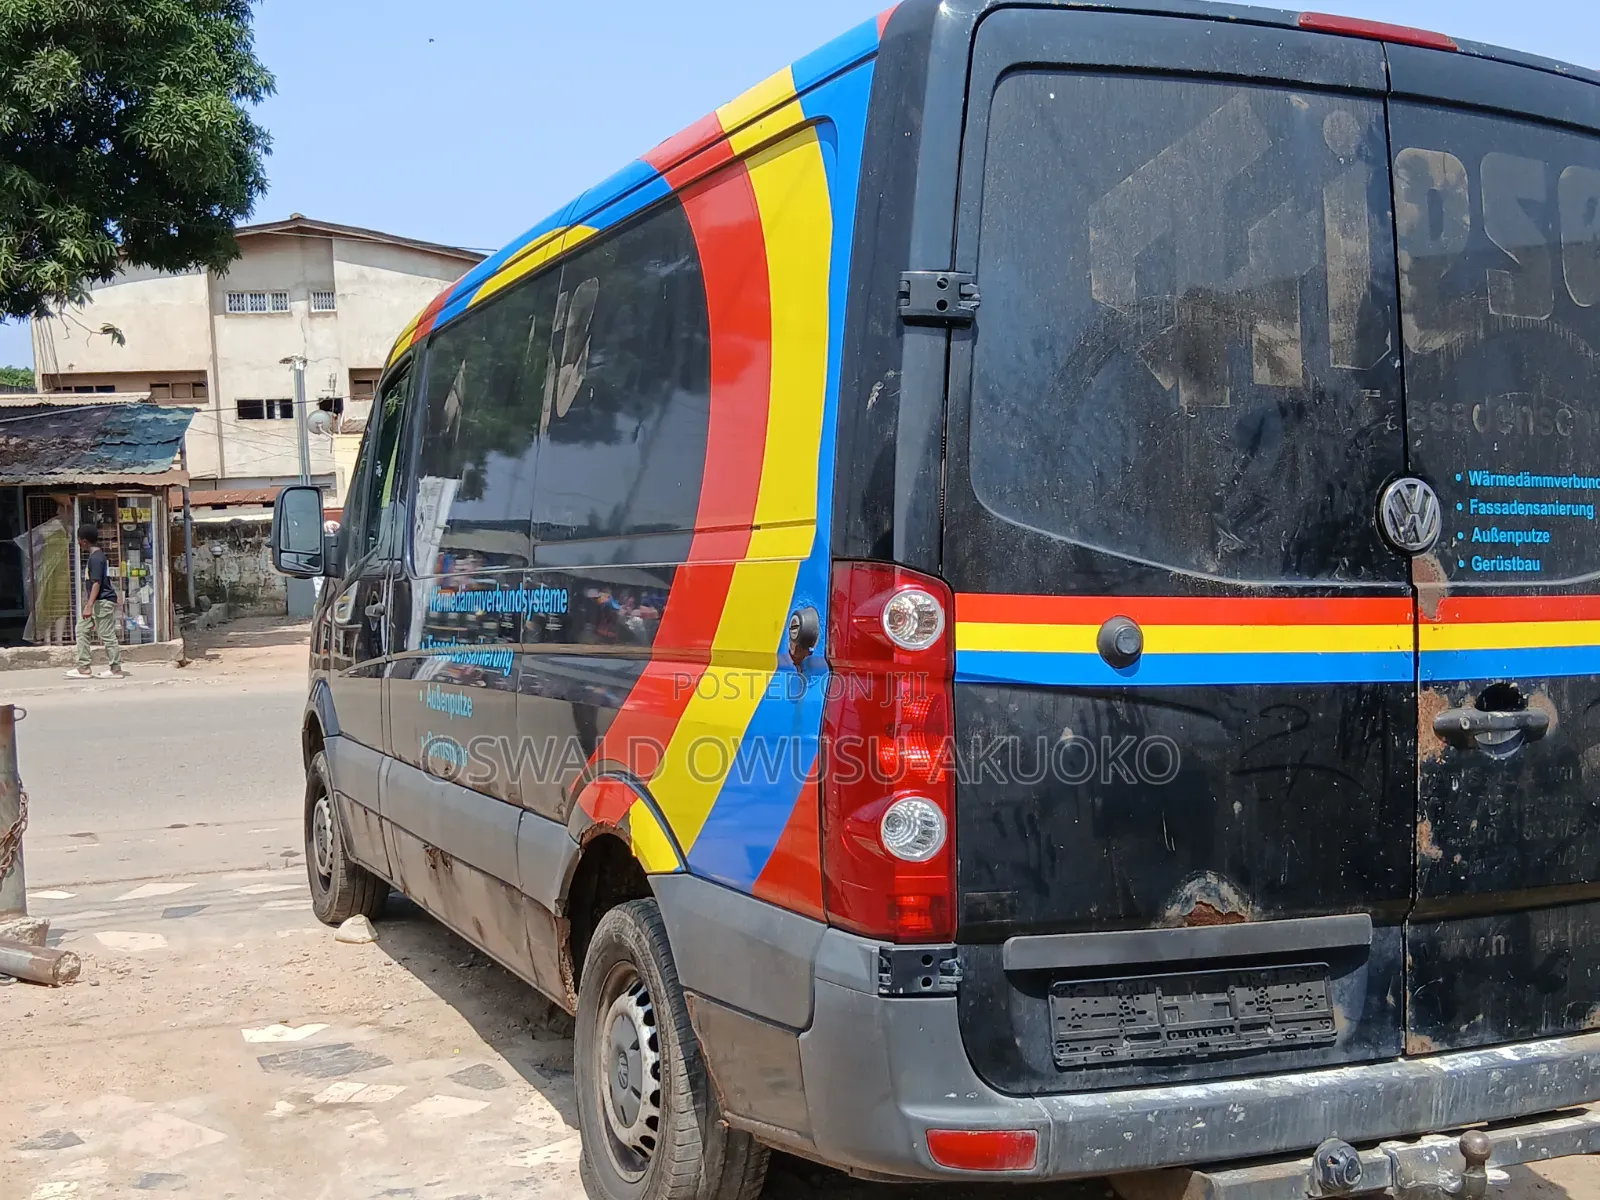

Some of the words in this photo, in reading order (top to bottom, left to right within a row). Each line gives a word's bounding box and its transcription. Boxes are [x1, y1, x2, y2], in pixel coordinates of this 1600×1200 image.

[1469, 498, 1595, 519] Fassadensanierung
[1471, 527, 1550, 546] Außenputze
[1471, 555, 1541, 572] Gerüstbau
[429, 582, 568, 621] Wärmedämmverbundsysteme
[426, 683, 473, 720] Außenputze
